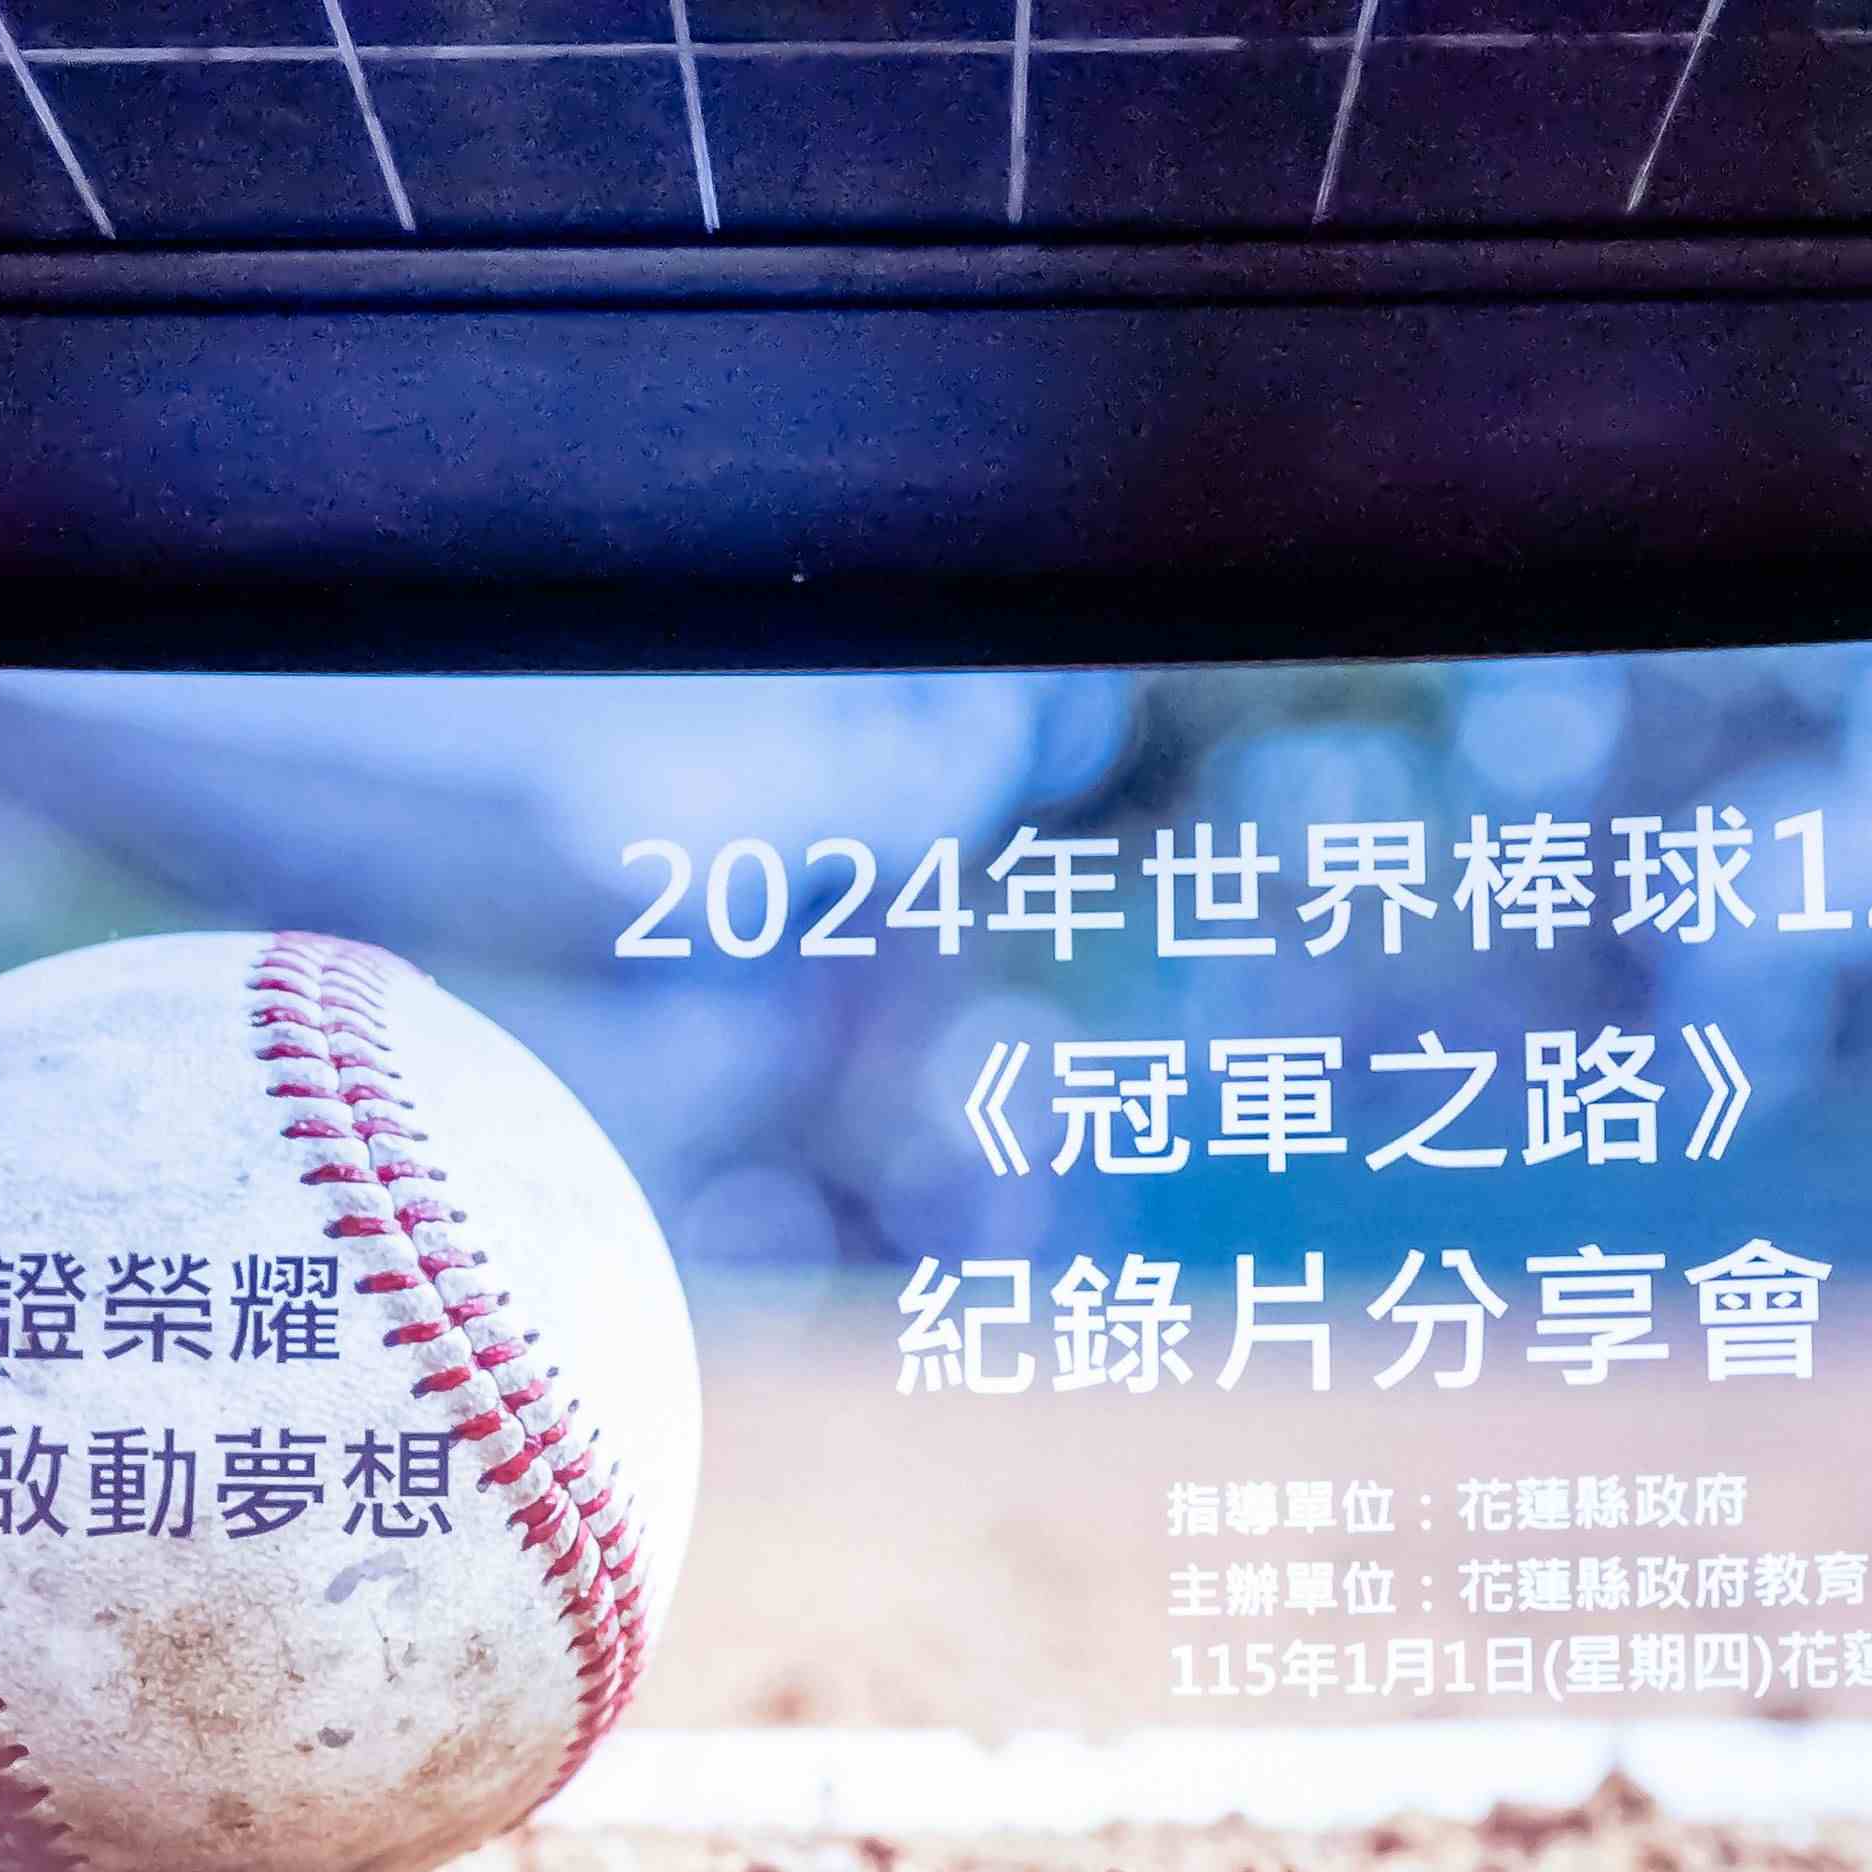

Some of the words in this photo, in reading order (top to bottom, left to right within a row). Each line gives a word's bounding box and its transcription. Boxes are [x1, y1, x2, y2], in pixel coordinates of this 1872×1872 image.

[960, 1022, 1754, 1180] 《冠軍之路》
[893, 1238, 1834, 1398] 紀錄片分享會
